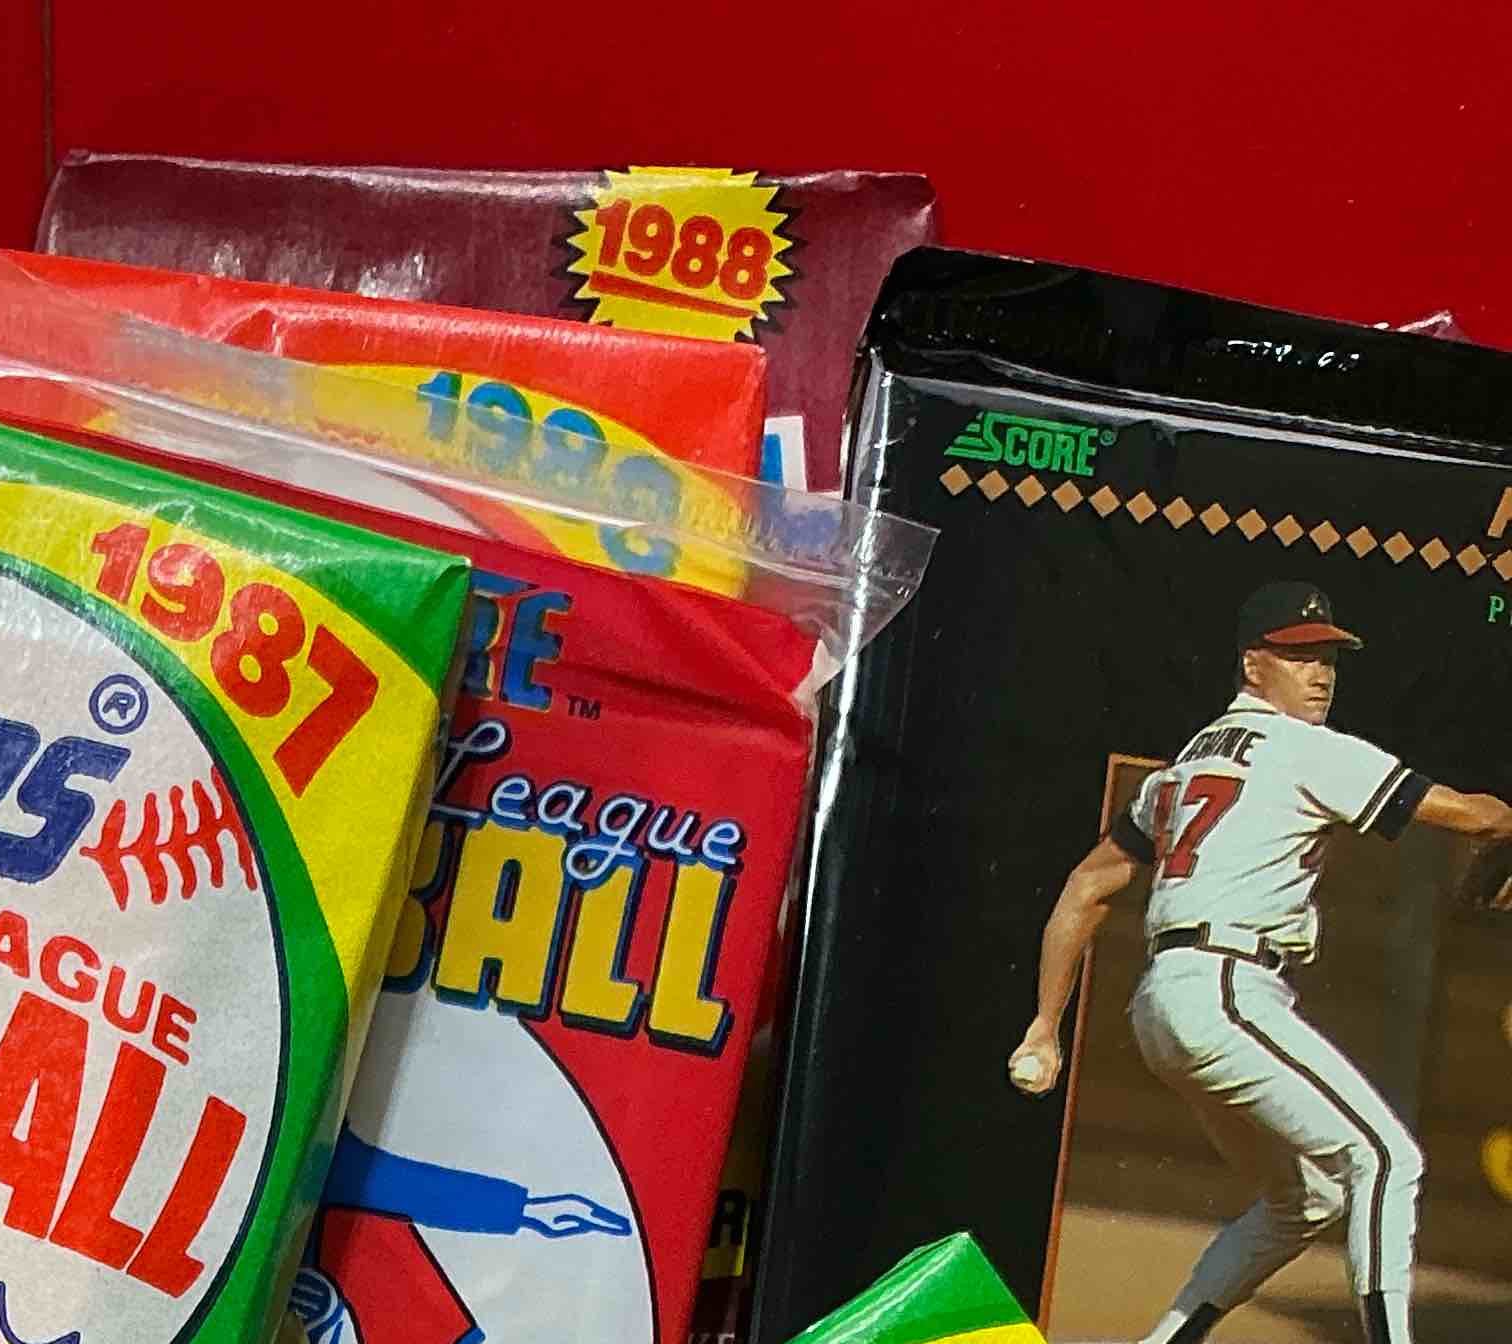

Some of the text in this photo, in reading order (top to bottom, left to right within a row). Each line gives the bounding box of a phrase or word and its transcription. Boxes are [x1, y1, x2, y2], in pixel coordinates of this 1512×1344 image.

[594, 202, 773, 301] 1988
[943, 410, 1098, 477] SCORE
[93, 524, 377, 797] 1987
